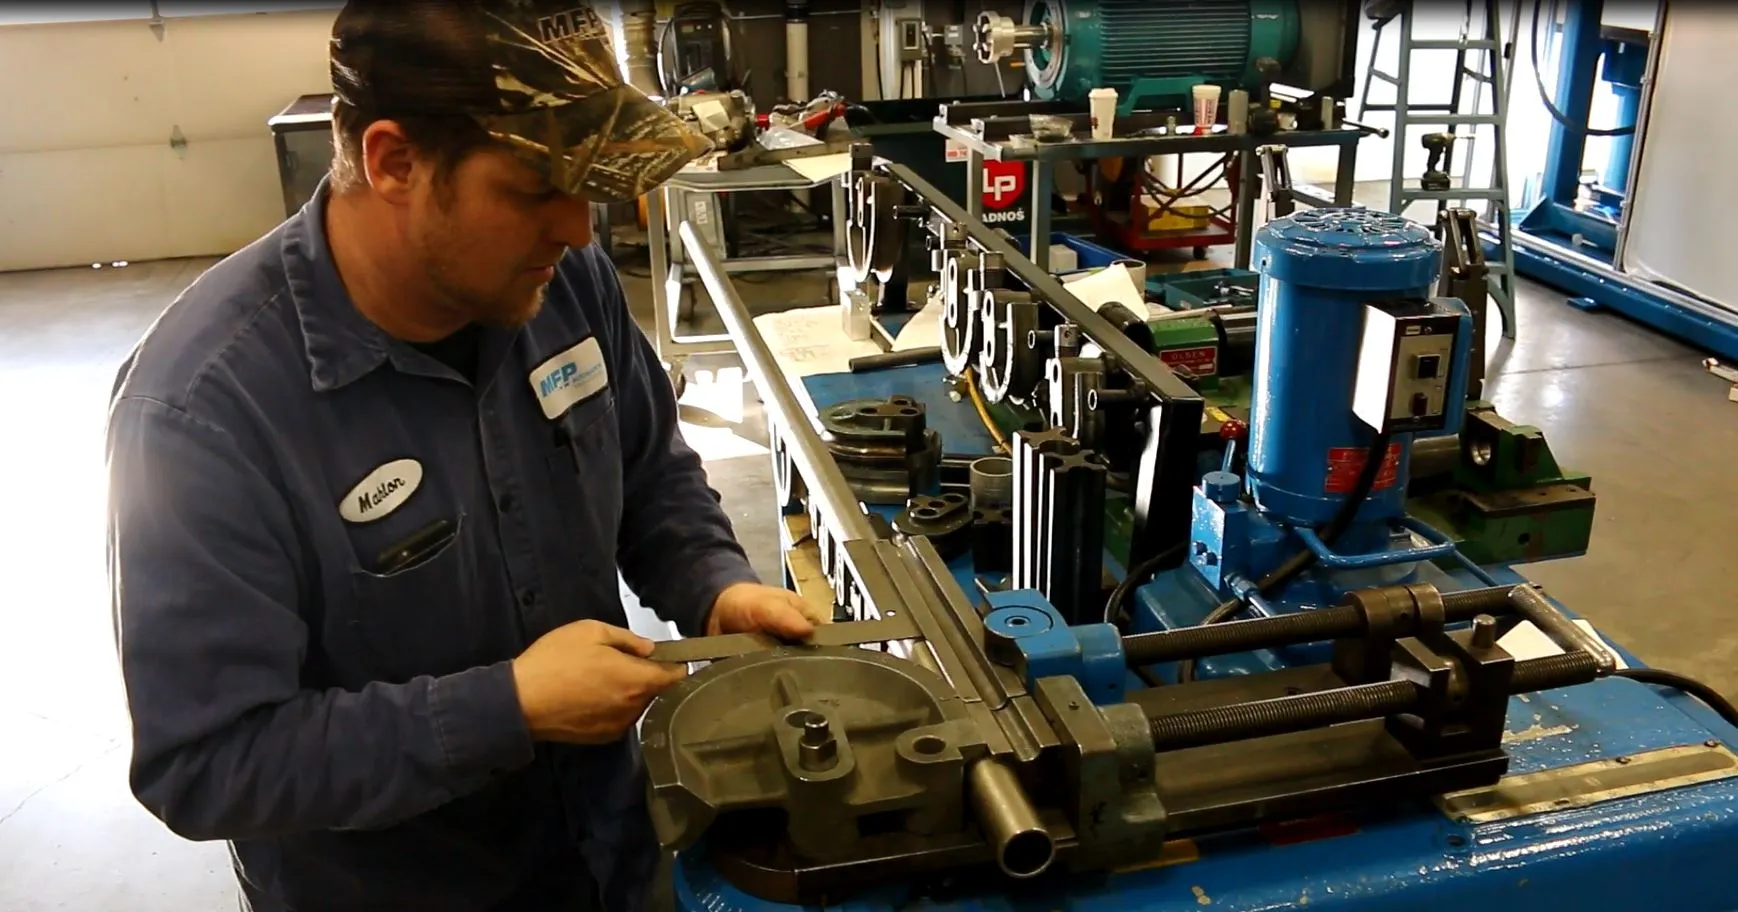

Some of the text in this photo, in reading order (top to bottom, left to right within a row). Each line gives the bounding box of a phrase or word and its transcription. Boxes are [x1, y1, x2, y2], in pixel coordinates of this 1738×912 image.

[537, 7, 600, 44] MFP
[540, 362, 578, 398] MFP
[358, 477, 406, 513] Mahlon
